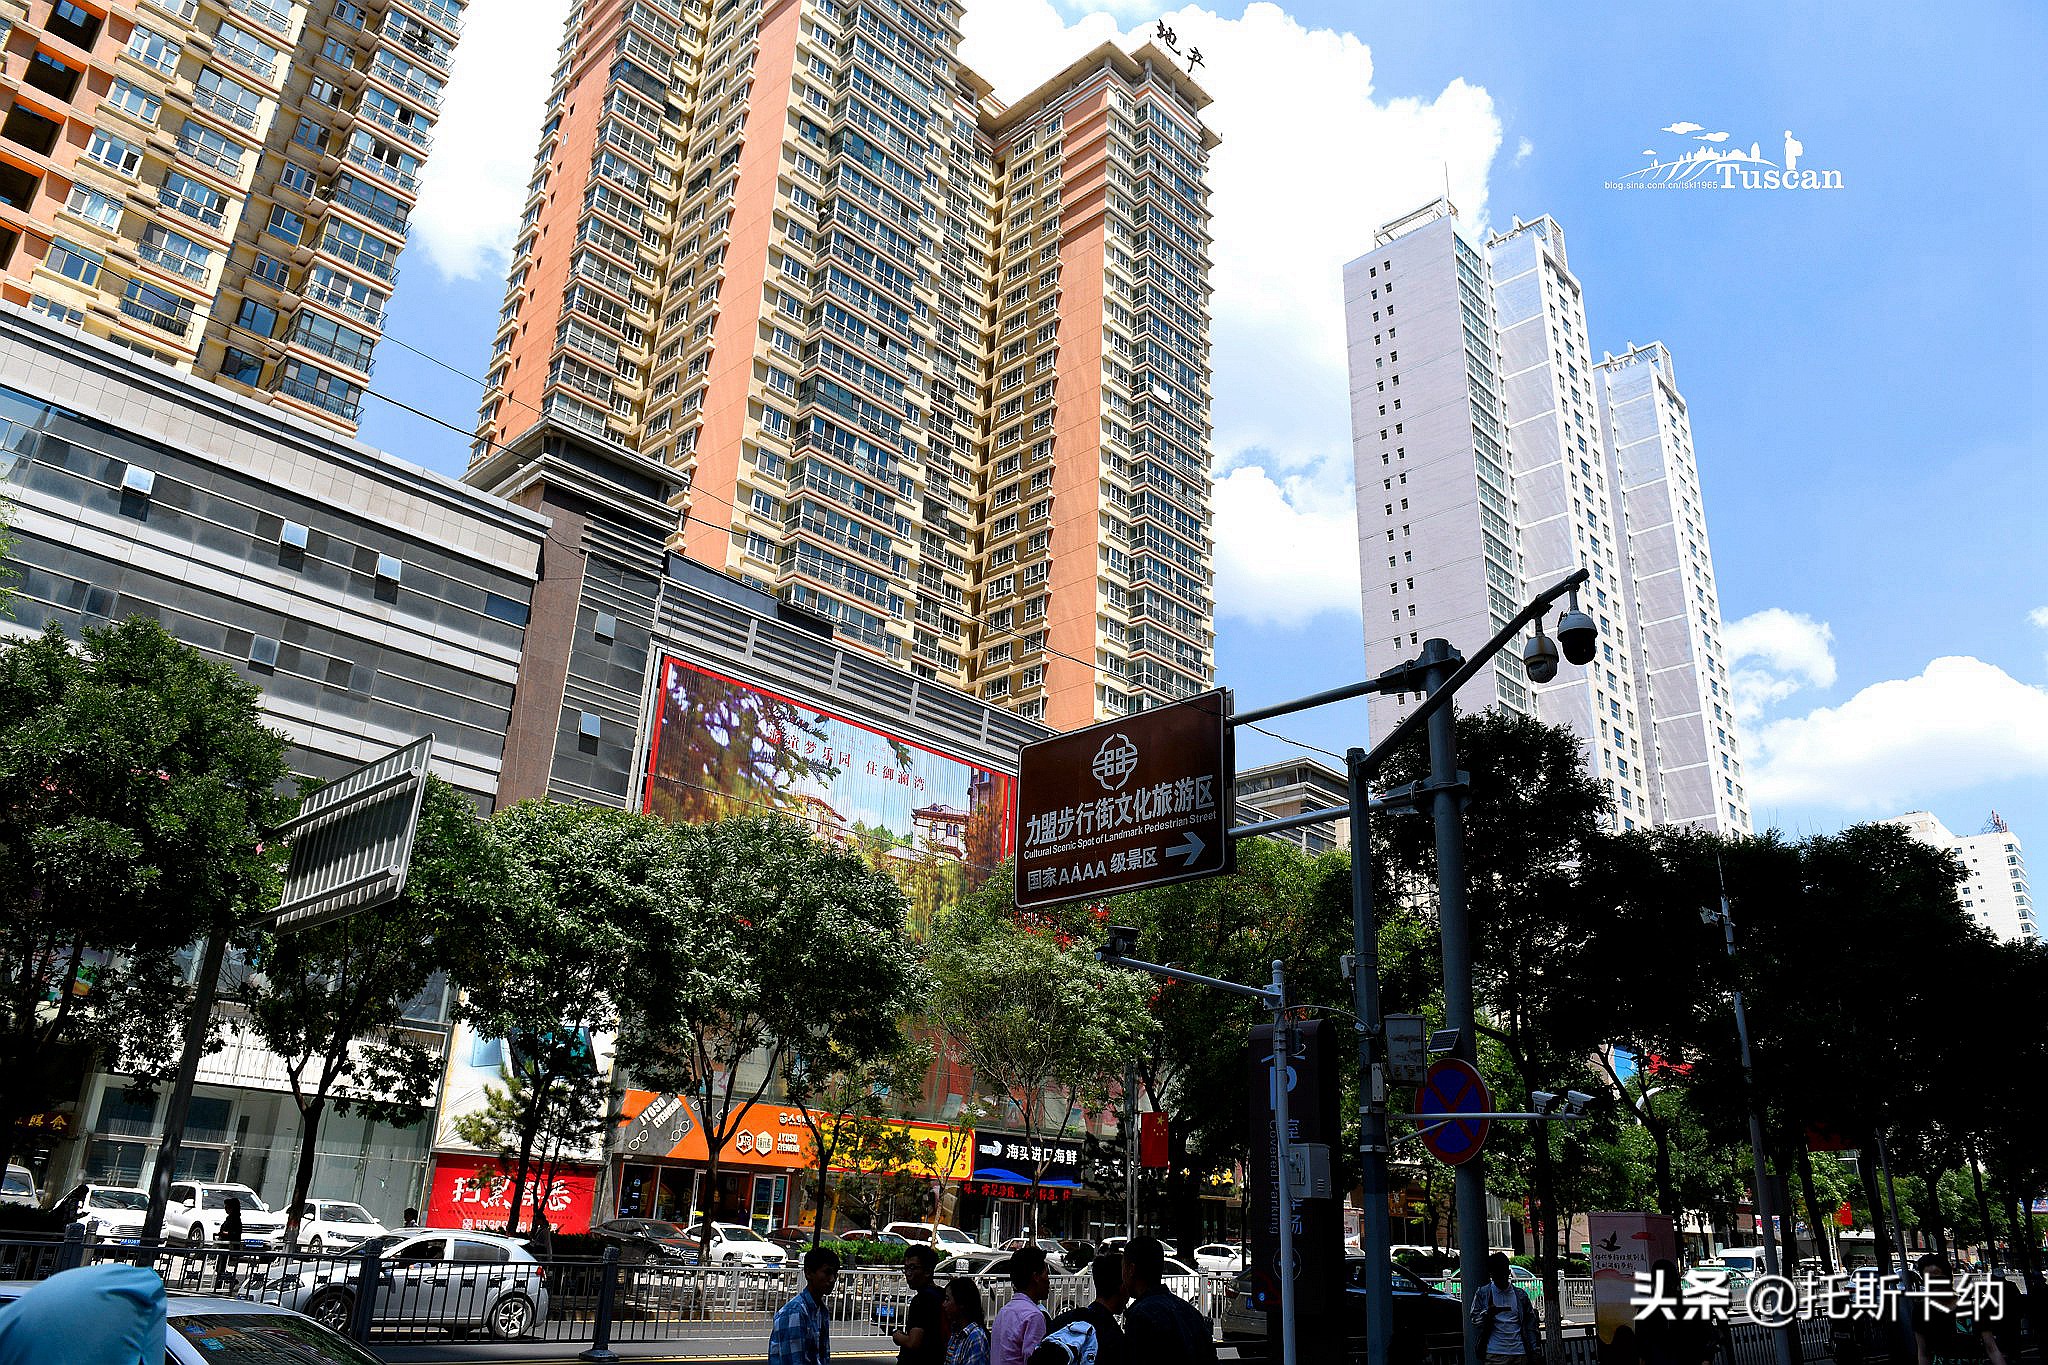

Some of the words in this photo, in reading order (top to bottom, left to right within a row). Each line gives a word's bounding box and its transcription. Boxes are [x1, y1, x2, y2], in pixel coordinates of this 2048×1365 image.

[1023, 844, 1052, 860] Cultural
[1052, 840, 1077, 855] Scenic
[1077, 836, 1095, 851] Spot
[1095, 833, 1104, 844] of
[1104, 825, 1144, 843] Landmark
[1144, 817, 1188, 834] Pedestrian
[1189, 810, 1217, 824] Street
[1024, 774, 1215, 848] 力盟步行街文化旅游区
[638, 1097, 667, 1127] JYOSO
[652, 1097, 683, 1129] EYEWEAR
[777, 1132, 798, 1144] JYOSO
[1269, 1119, 1279, 1177] Covered
[1269, 1181, 1280, 1235] Parking
